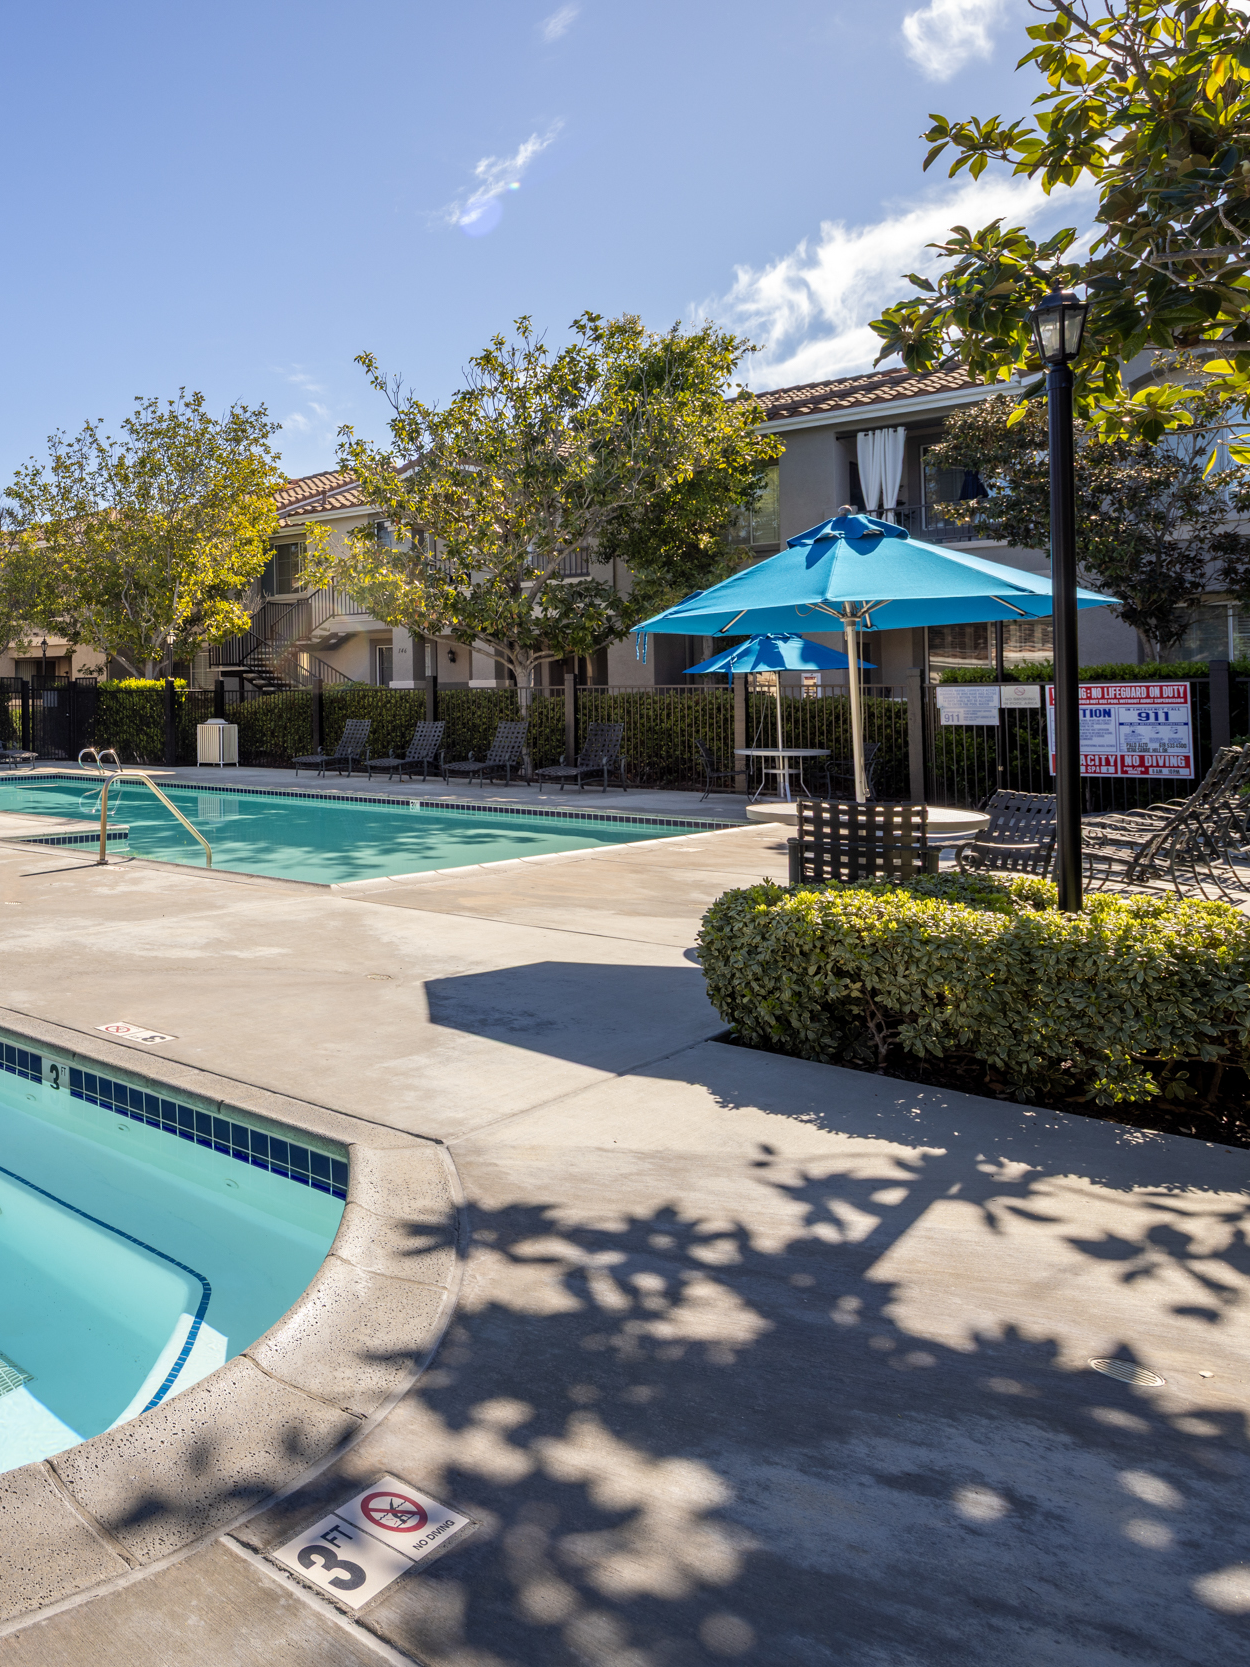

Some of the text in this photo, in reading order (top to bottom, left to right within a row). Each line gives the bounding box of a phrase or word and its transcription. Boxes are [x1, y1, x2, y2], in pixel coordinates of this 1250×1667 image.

[1092, 687, 1102, 698] NO
[1104, 686, 1147, 698] LIFEGUARD
[1149, 686, 1160, 697] ON
[1162, 686, 1184, 697] DUTY
[944, 714, 960, 722] 911
[1137, 711, 1169, 721] 911
[1125, 755, 1185, 766] NO DIVING
[50, 1064, 66, 1090] 3 FT
[320, 1524, 353, 1548] FT
[412, 1520, 455, 1550] NO DIVING
[297, 1544, 366, 1590] 3
